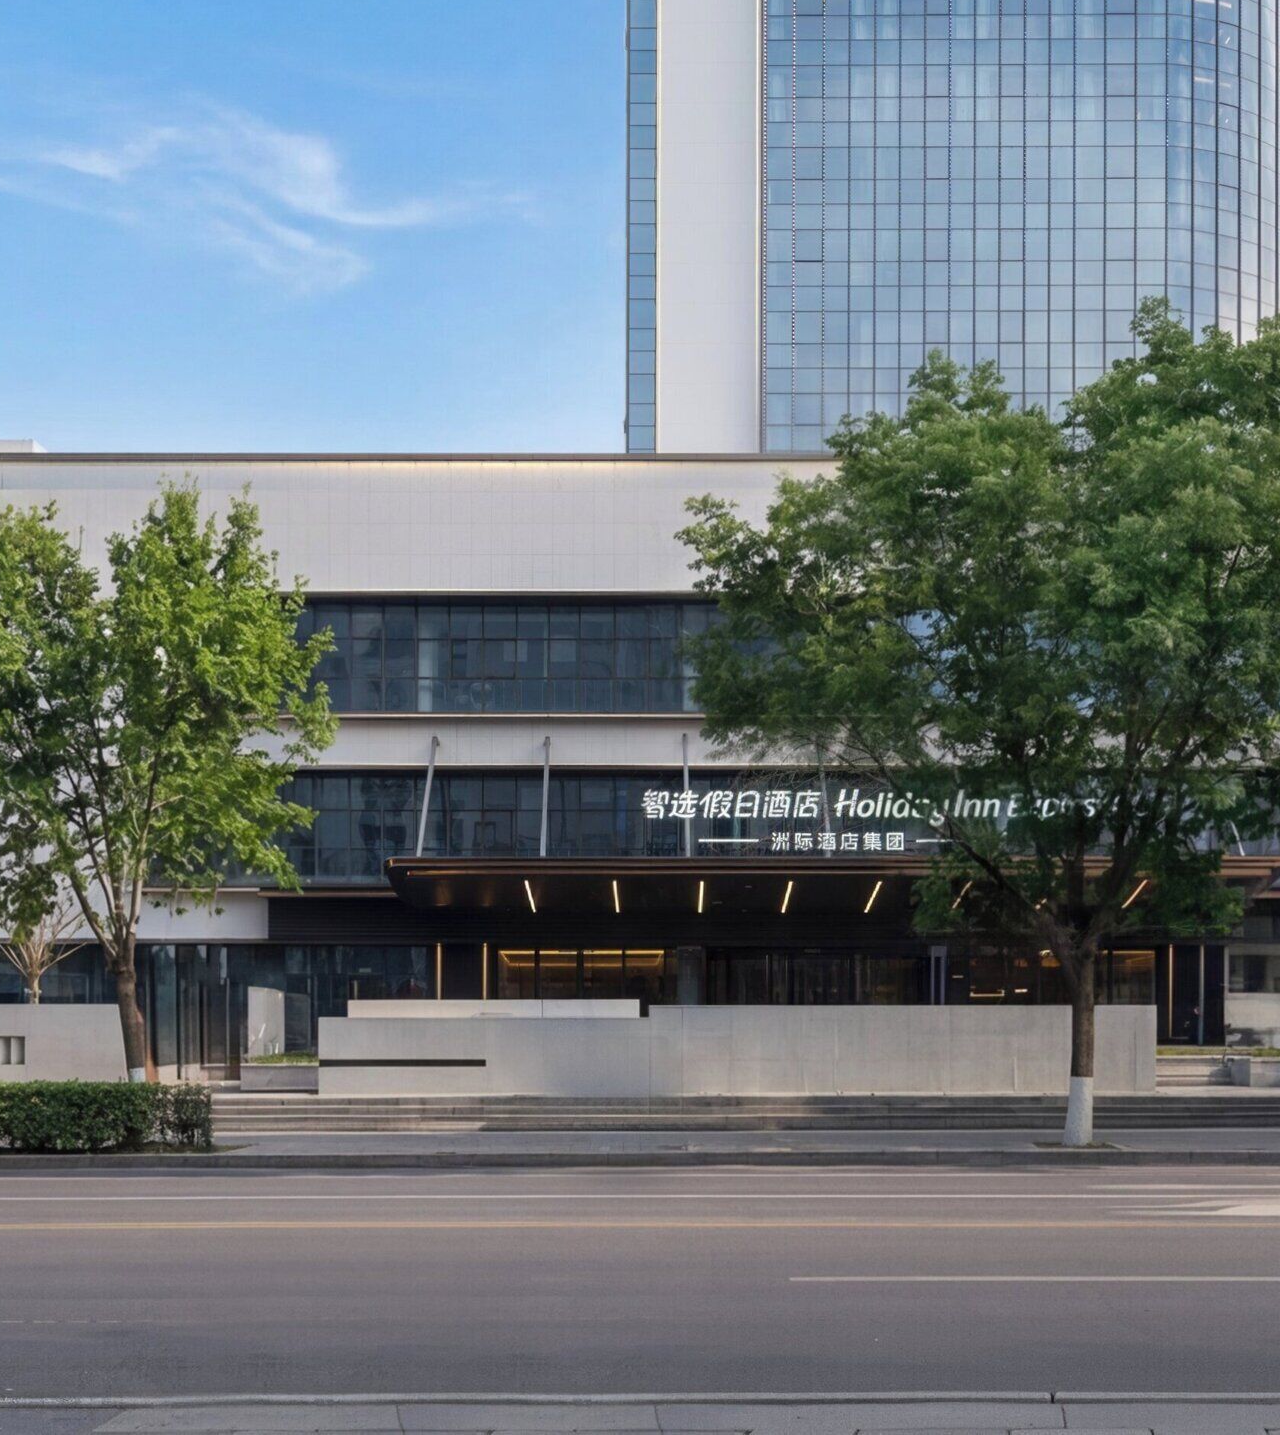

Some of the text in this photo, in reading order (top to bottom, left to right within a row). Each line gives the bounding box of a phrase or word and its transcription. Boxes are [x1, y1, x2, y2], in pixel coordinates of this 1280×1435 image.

[641, 788, 822, 819] 智选假日酒店
[954, 789, 1001, 818] Inn
[771, 832, 905, 851] 洲际酒店集团
